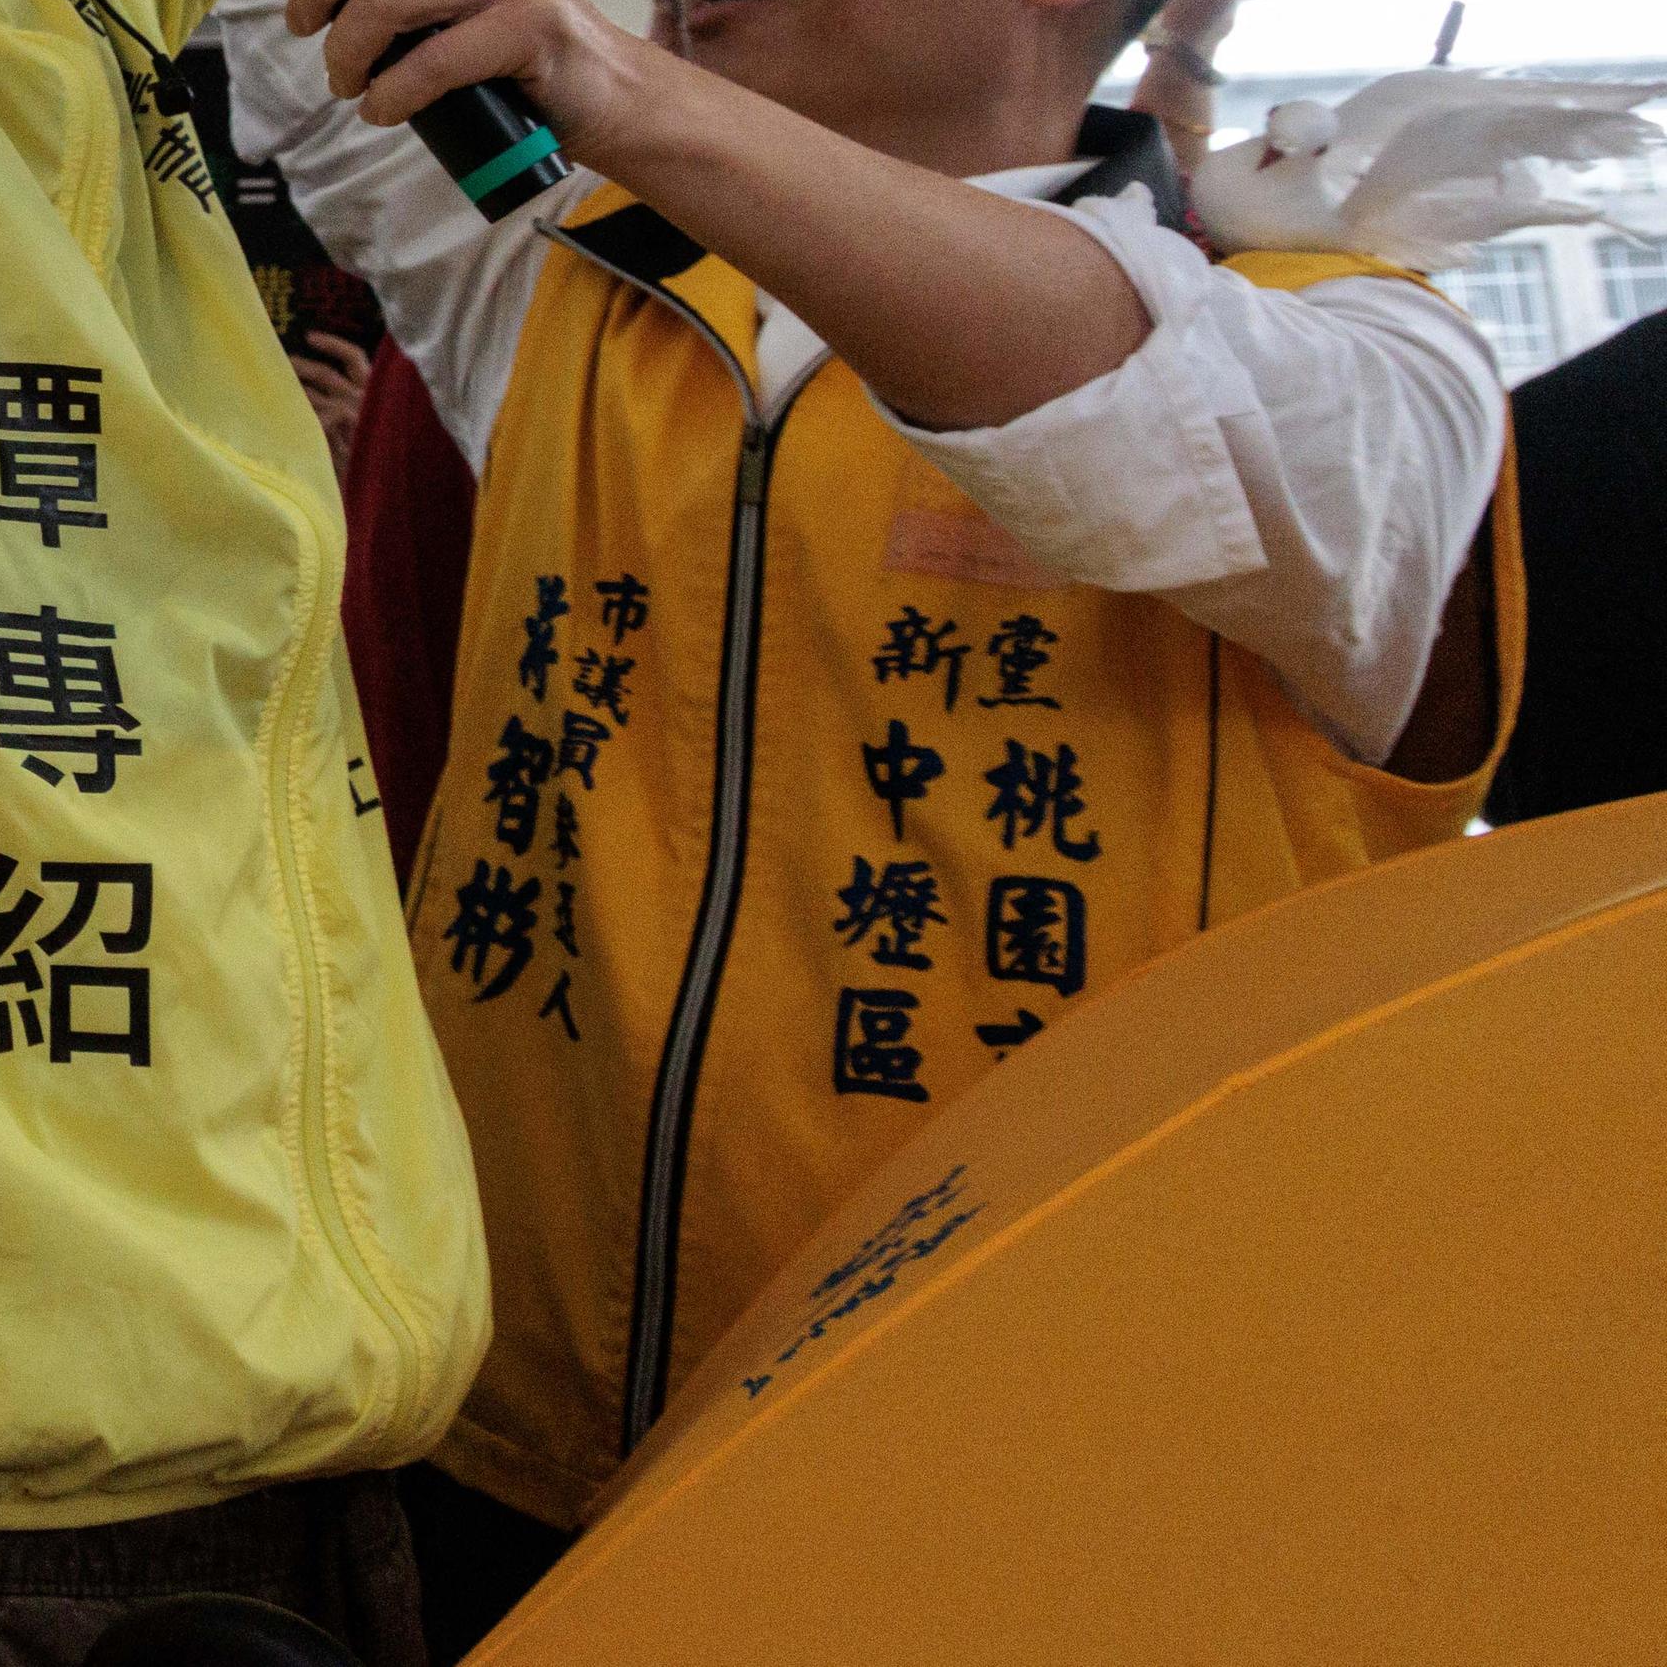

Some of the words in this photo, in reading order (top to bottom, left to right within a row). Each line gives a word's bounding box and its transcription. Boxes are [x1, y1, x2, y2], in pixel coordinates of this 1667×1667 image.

[873, 605, 1062, 714] 新黨
[833, 718, 948, 1104] 中壢區
